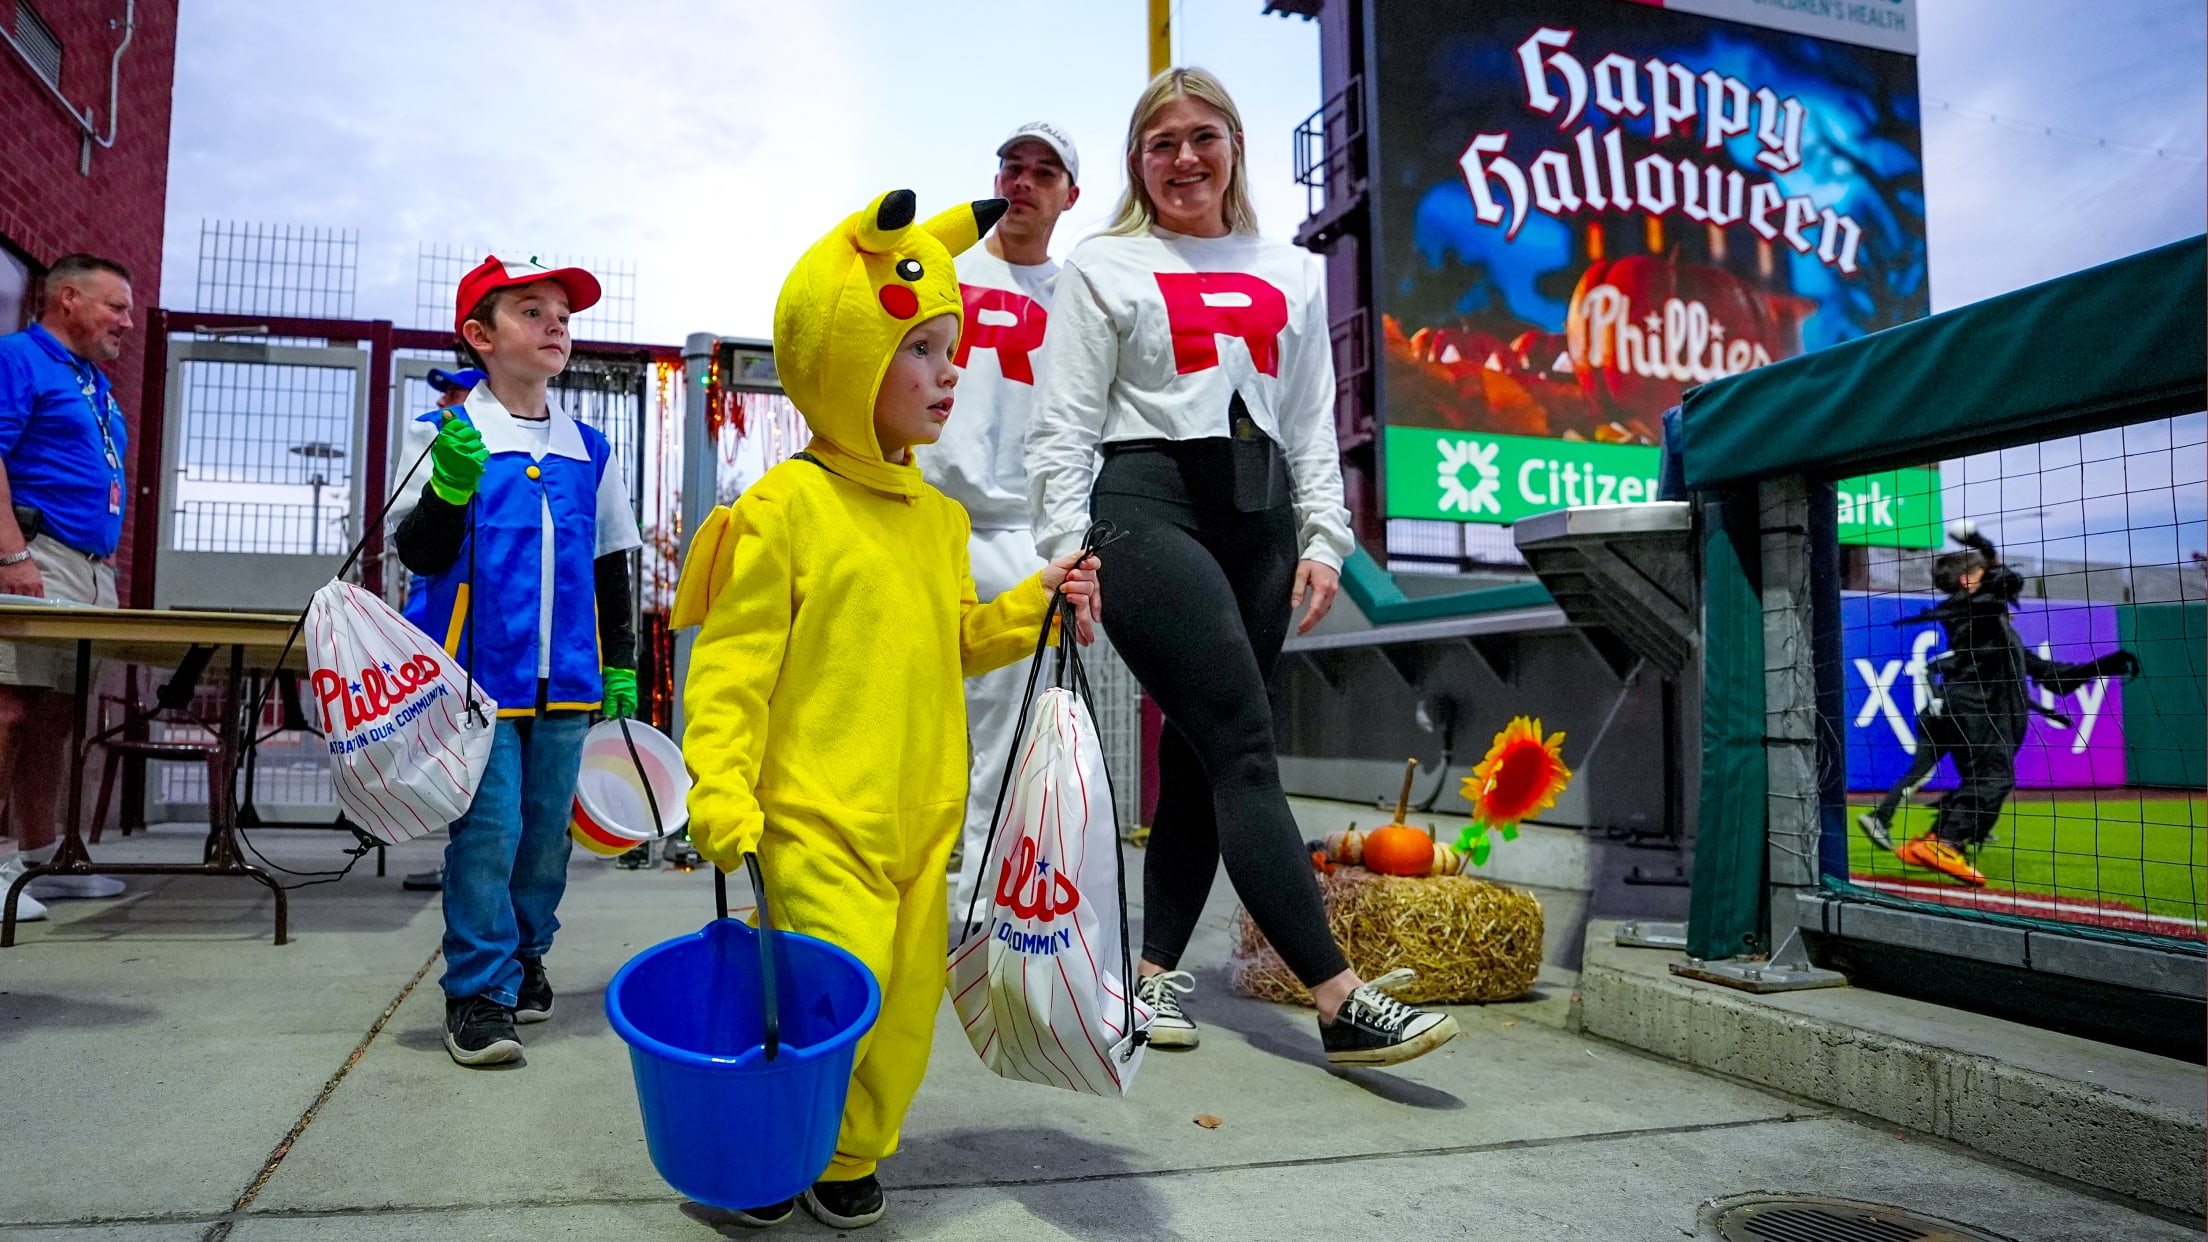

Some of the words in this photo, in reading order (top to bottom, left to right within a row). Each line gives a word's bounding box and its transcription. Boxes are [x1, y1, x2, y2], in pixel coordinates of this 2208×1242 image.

[1754, 0, 1843, 20] LDREN'S
[1847, 3, 1906, 30] HEALTH
[1516, 27, 1807, 172] Happy
[1459, 125, 1862, 275] Halloween
[952, 282, 1048, 386] R
[1153, 271, 1288, 379] R
[1837, 481, 1894, 527] ark
[369, 720, 396, 742] OUR
